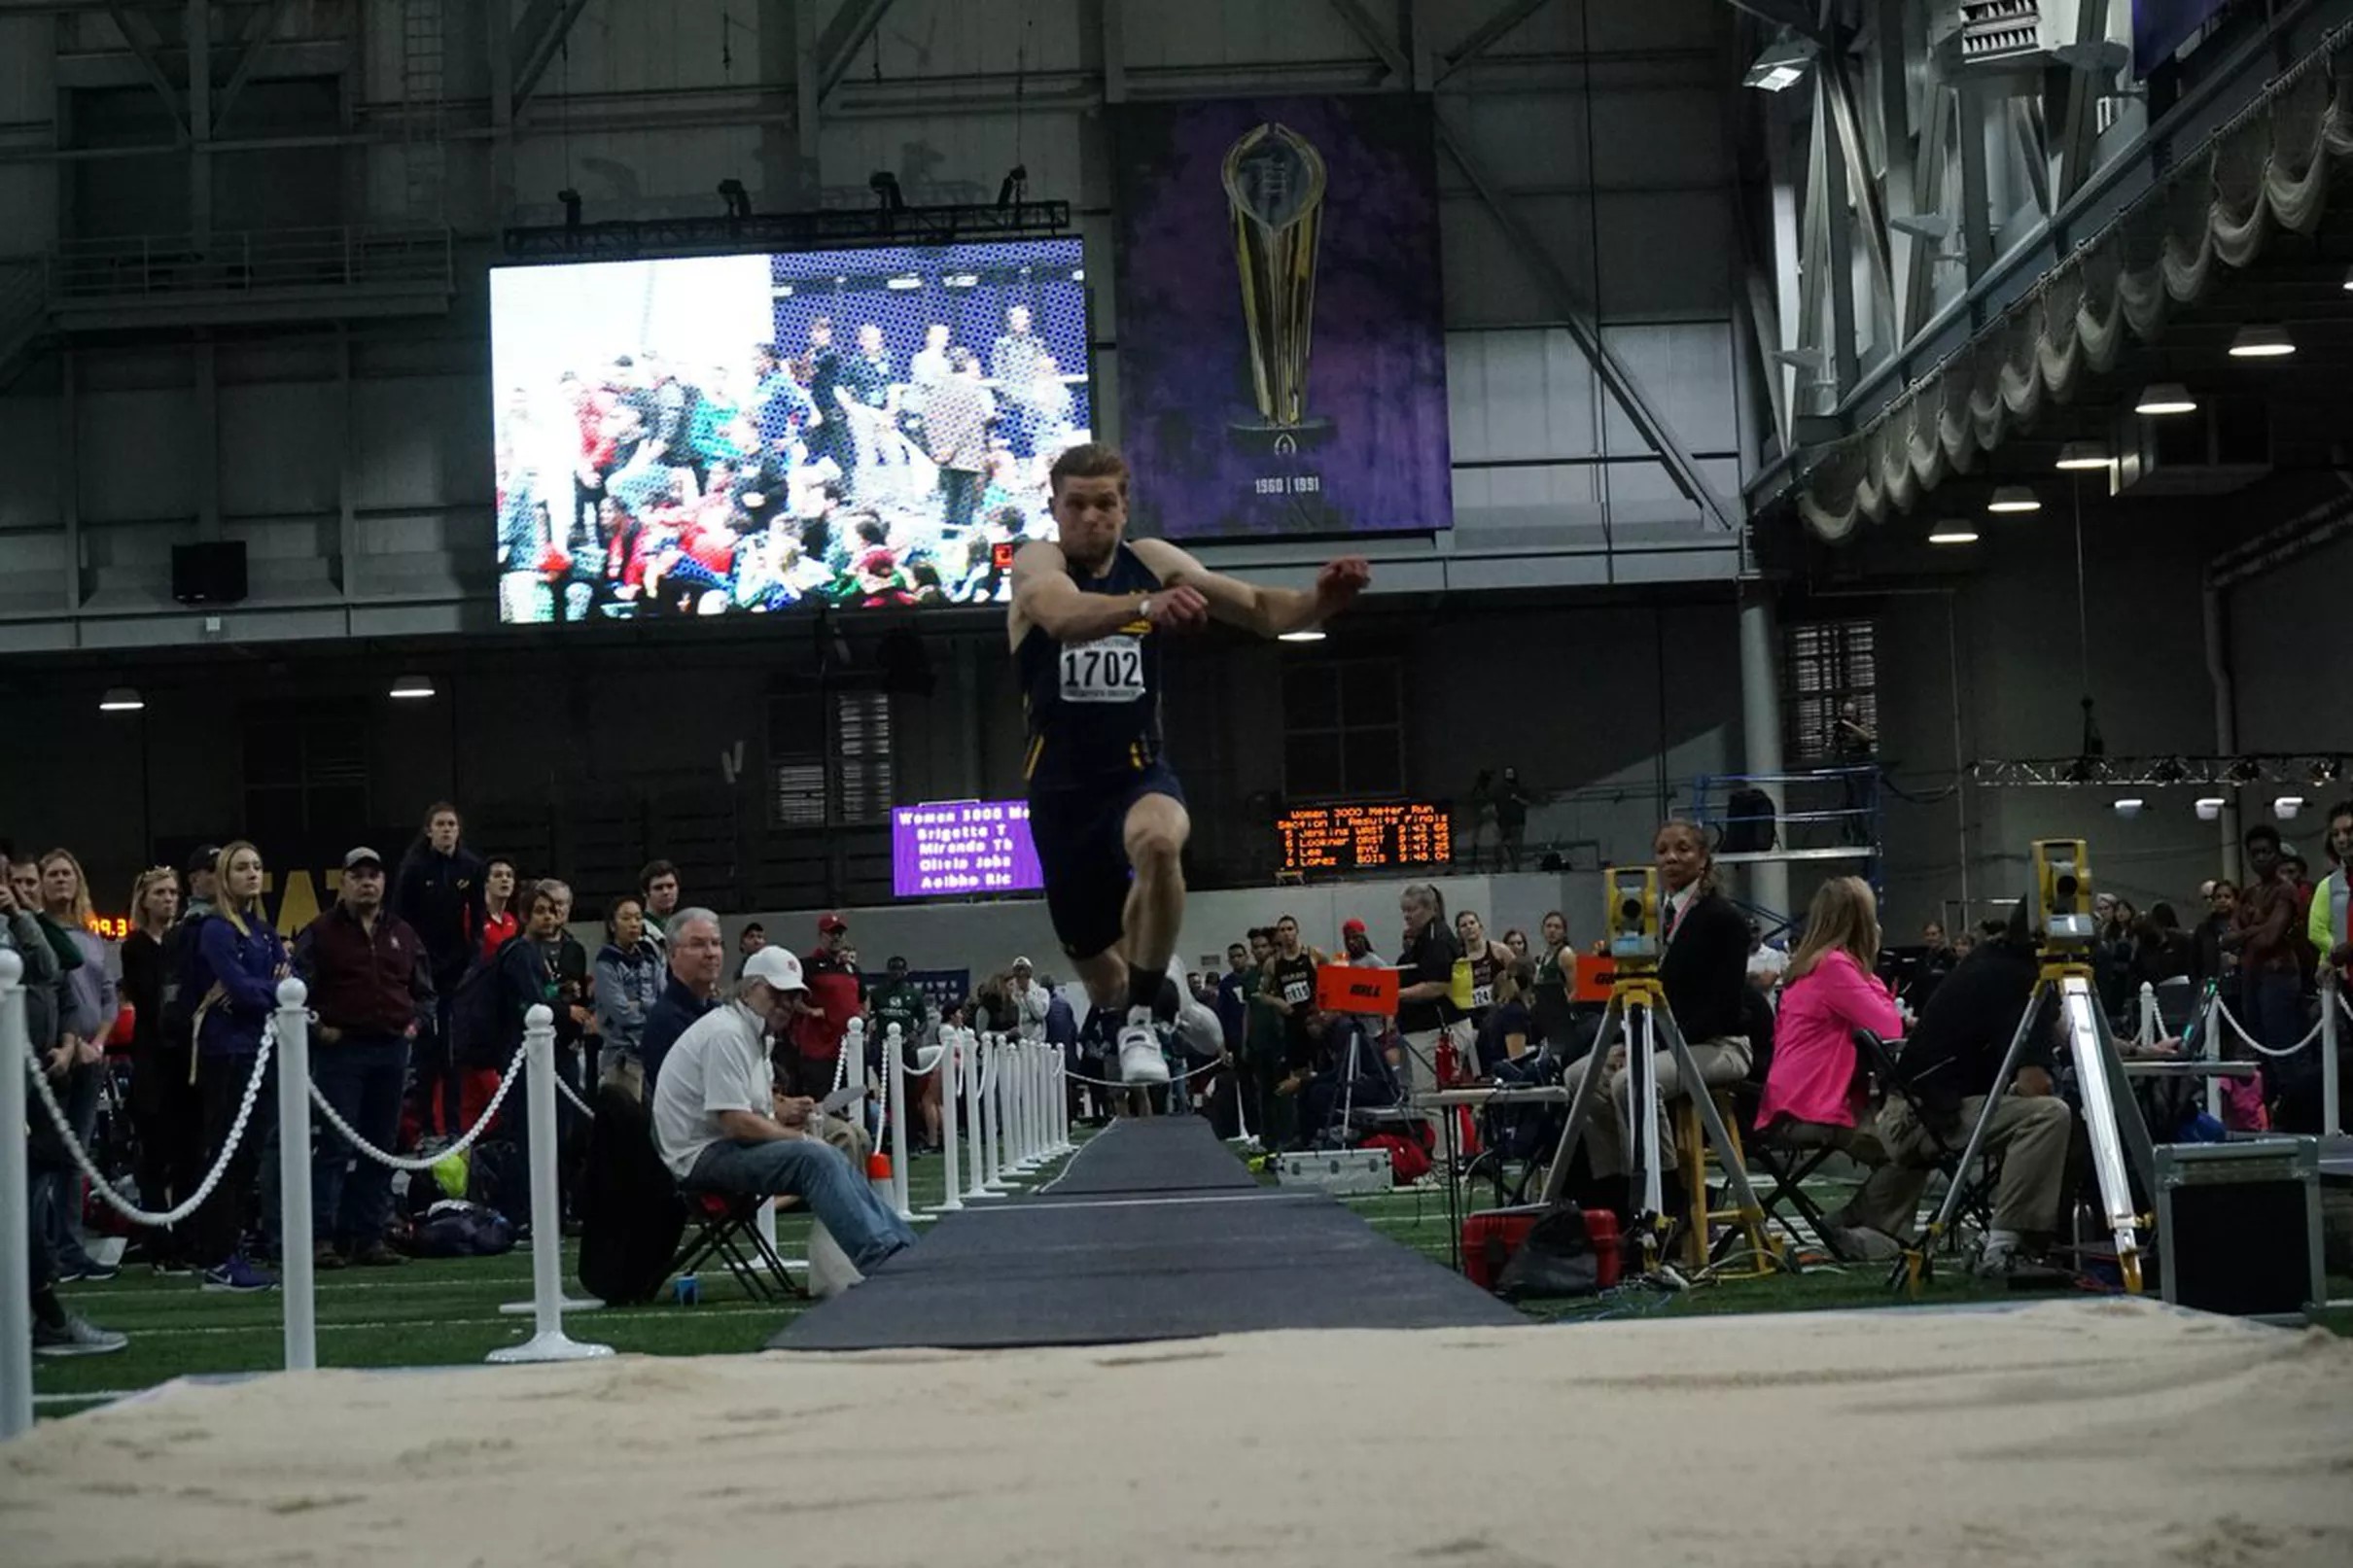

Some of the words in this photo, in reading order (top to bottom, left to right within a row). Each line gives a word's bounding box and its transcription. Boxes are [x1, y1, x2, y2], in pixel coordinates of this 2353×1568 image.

[1255, 477, 1283, 494] 1960
[1293, 475, 1319, 493] 1991
[1066, 650, 1139, 687] 1702
[898, 812, 956, 825] Women
[1334, 808, 1363, 818] 3000
[1411, 804, 1434, 815] Run
